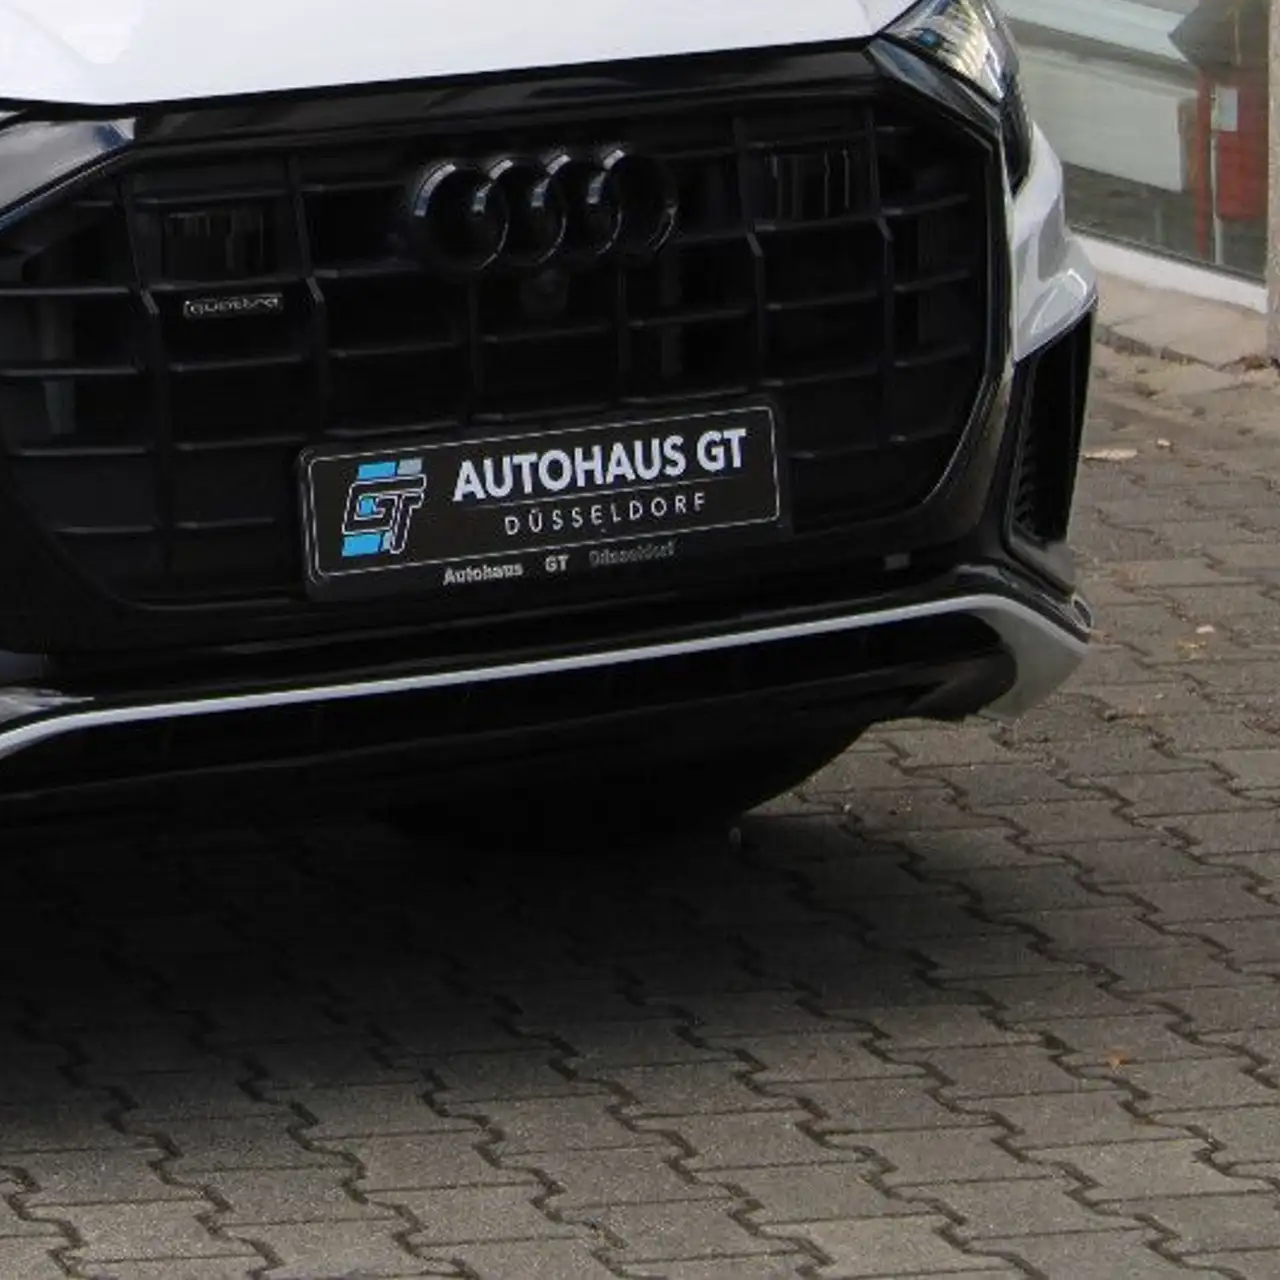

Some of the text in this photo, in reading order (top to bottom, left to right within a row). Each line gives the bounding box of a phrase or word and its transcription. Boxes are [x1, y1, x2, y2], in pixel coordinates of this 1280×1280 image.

[452, 428, 747, 502] AUTOHAUS GT
[504, 492, 706, 536] DÜSSELDORF
[442, 563, 524, 586] Autohaus
[545, 554, 570, 573] GT
